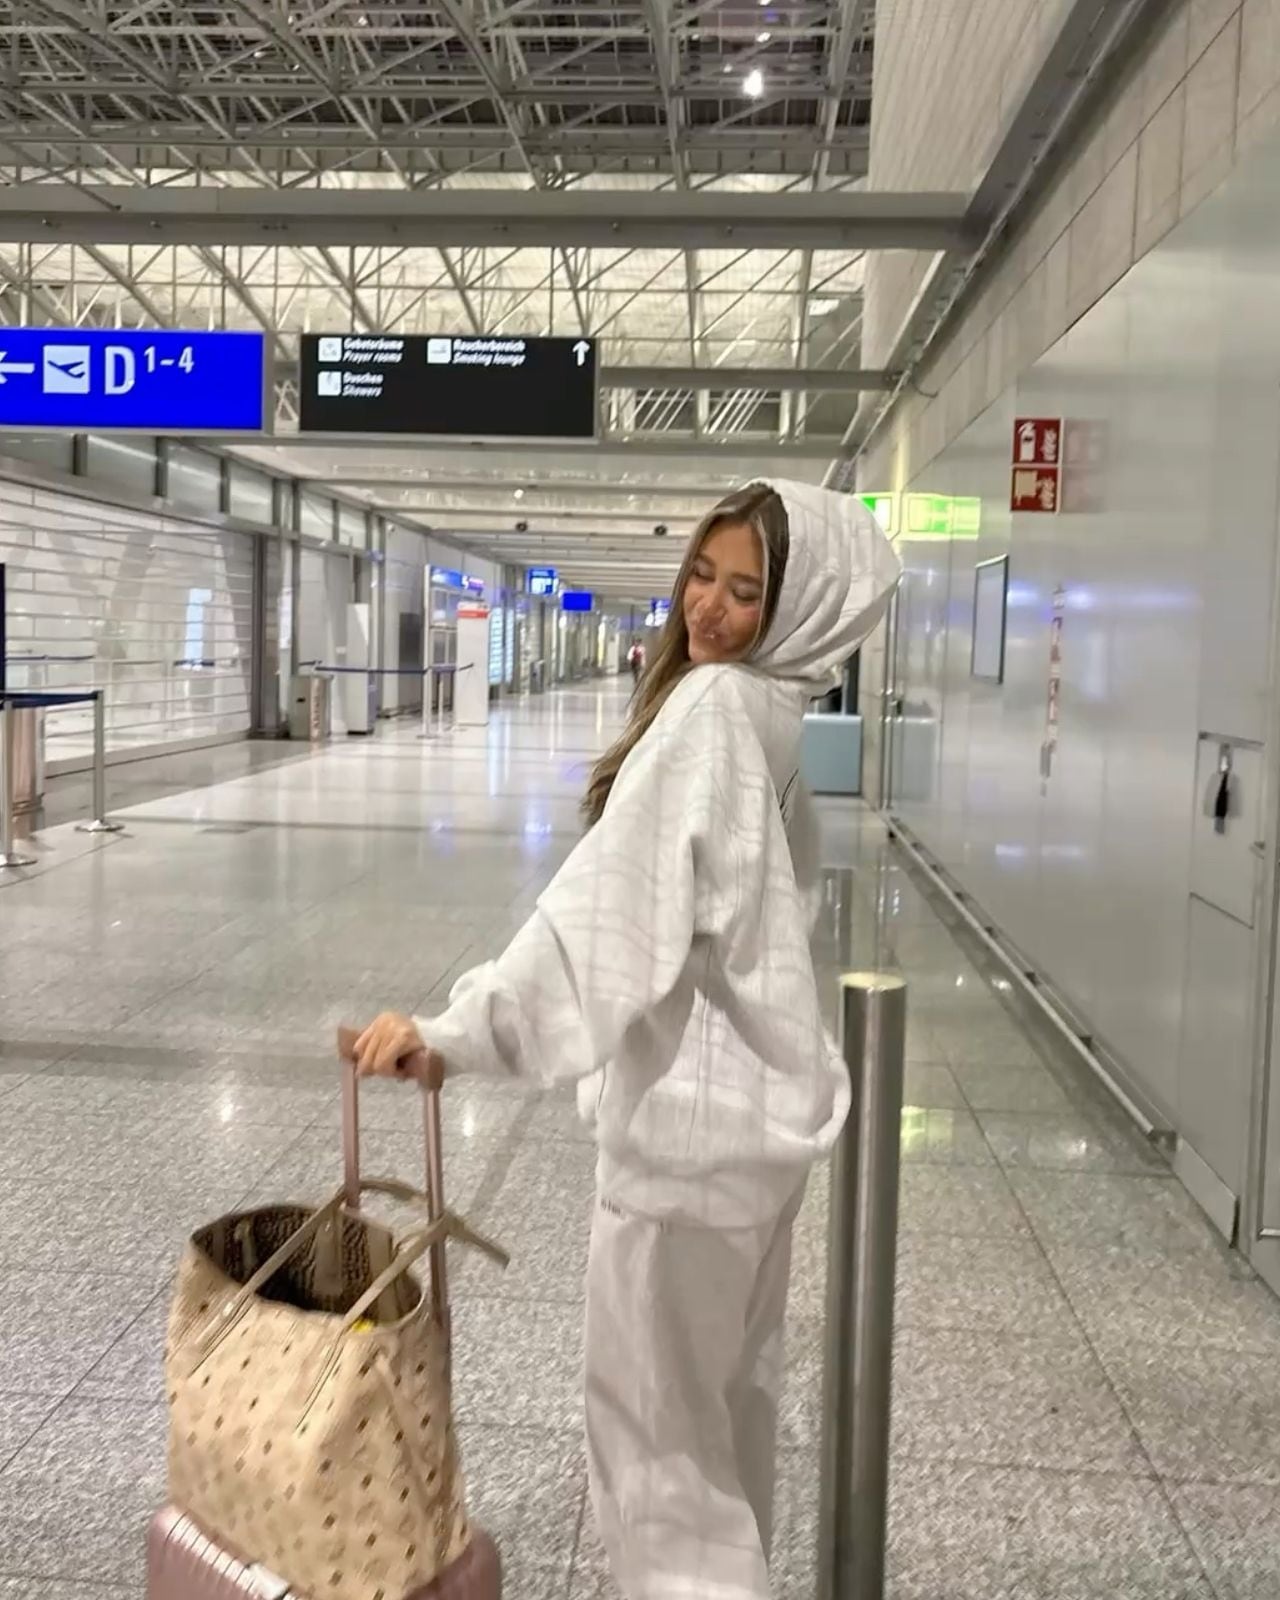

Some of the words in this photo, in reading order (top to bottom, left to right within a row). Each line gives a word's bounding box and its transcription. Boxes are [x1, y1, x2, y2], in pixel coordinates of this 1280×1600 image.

[342, 350, 374, 364] Prayer
[373, 352, 403, 363] rooms
[452, 351, 494, 366] Smoking
[491, 352, 526, 367] lounge
[104, 345, 136, 395] D
[143, 345, 195, 374] 1-4
